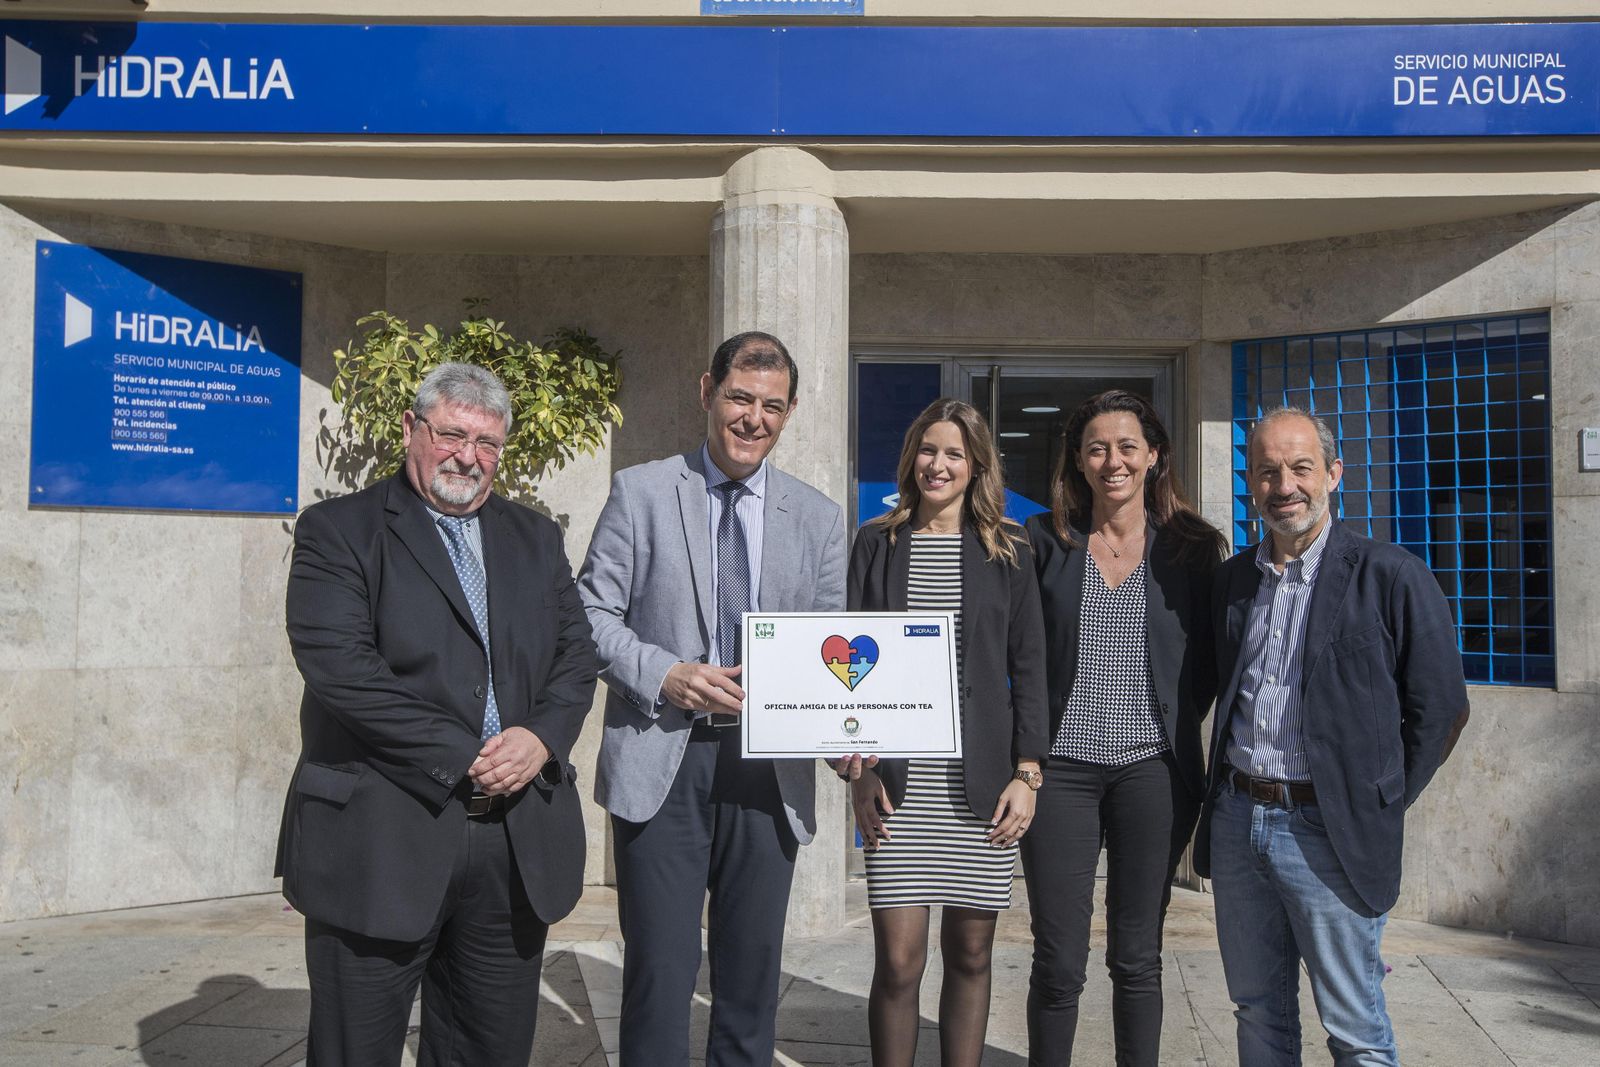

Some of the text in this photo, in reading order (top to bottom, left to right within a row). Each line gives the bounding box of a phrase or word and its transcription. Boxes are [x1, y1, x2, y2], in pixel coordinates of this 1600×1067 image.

[1393, 52, 1566, 70] SERVICIO MUNICIPAL
[1393, 74, 1567, 106] DE AGUAS
[113, 353, 281, 378] SERVICIO MUNICIPAL DE AGUAS
[113, 373, 237, 391] Horario de atención al público
[113, 384, 126, 393] De
[127, 386, 150, 395] lunes
[158, 388, 188, 398] viernes
[189, 390, 200, 399] de
[201, 392, 225, 401] 09.00
[225, 394, 233, 402] h.
[242, 394, 264, 404] 13.00
[113, 395, 207, 411] Tel. atención al cliente
[114, 408, 131, 417] 900
[132, 409, 149, 418] 555
[112, 418, 178, 431] Tel. incidencias
[114, 429, 131, 438] 900
[132, 431, 149, 440] 555
[111, 443, 195, 455] www.hidralia-sa.es
